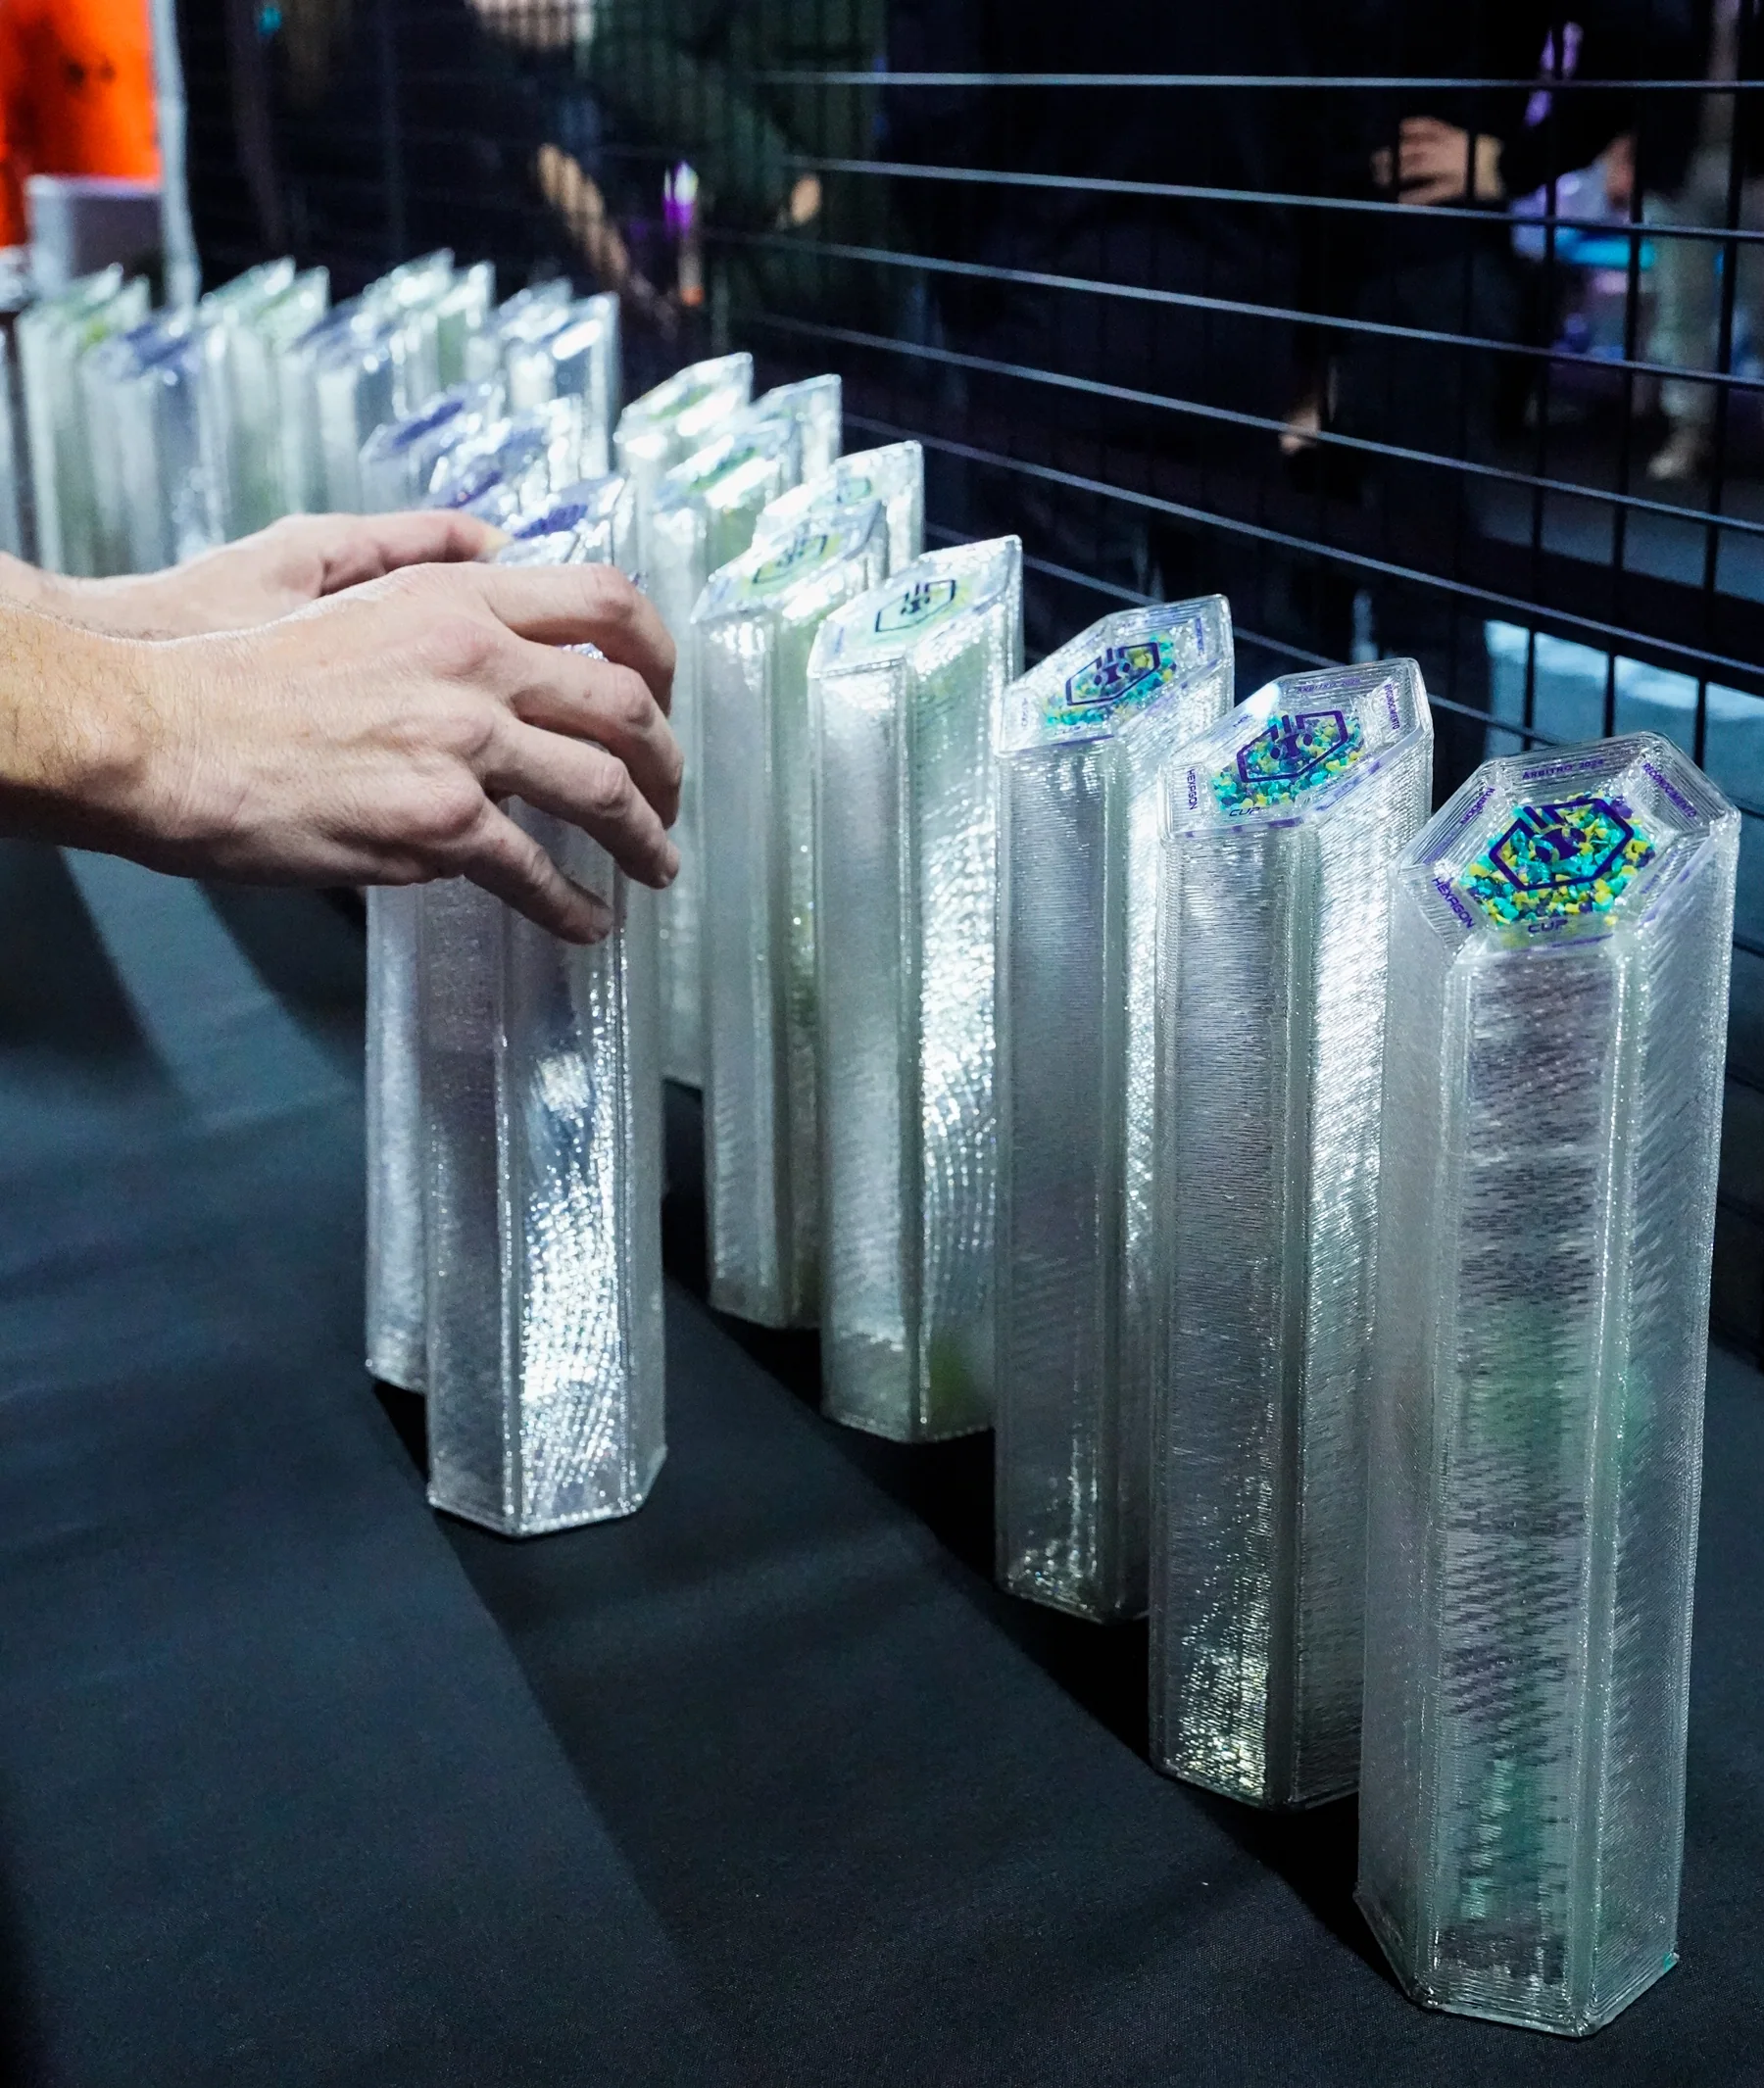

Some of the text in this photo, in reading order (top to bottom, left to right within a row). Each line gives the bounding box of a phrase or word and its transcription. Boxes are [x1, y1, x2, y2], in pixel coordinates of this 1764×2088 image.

[1228, 806, 1261, 817] CUP
[1432, 876, 1476, 930] HEXAGON
[1527, 917, 1568, 935] CUP
